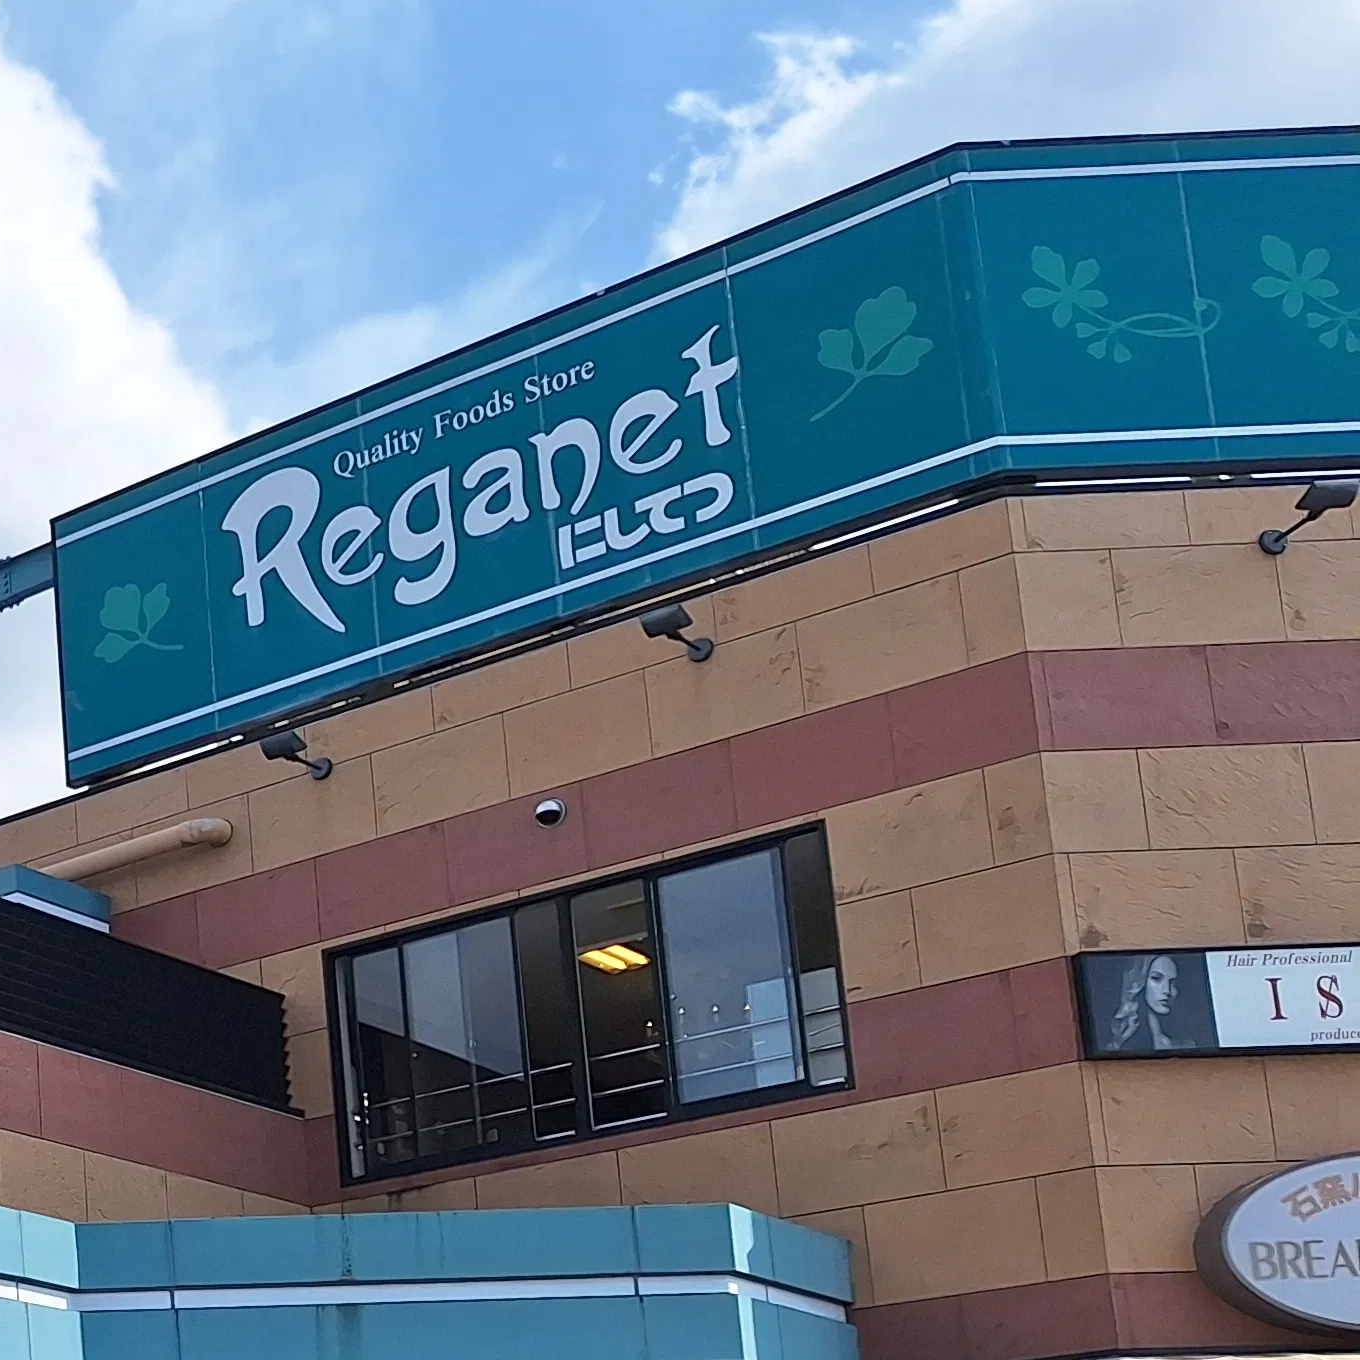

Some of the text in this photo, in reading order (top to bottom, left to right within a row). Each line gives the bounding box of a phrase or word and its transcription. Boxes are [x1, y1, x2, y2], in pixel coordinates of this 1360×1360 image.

[333, 356, 596, 479] Quality Foods Store
[221, 324, 740, 634] Reganet
[1226, 950, 1352, 968] Hair Professional
[1247, 1239, 1360, 1280] BREA
